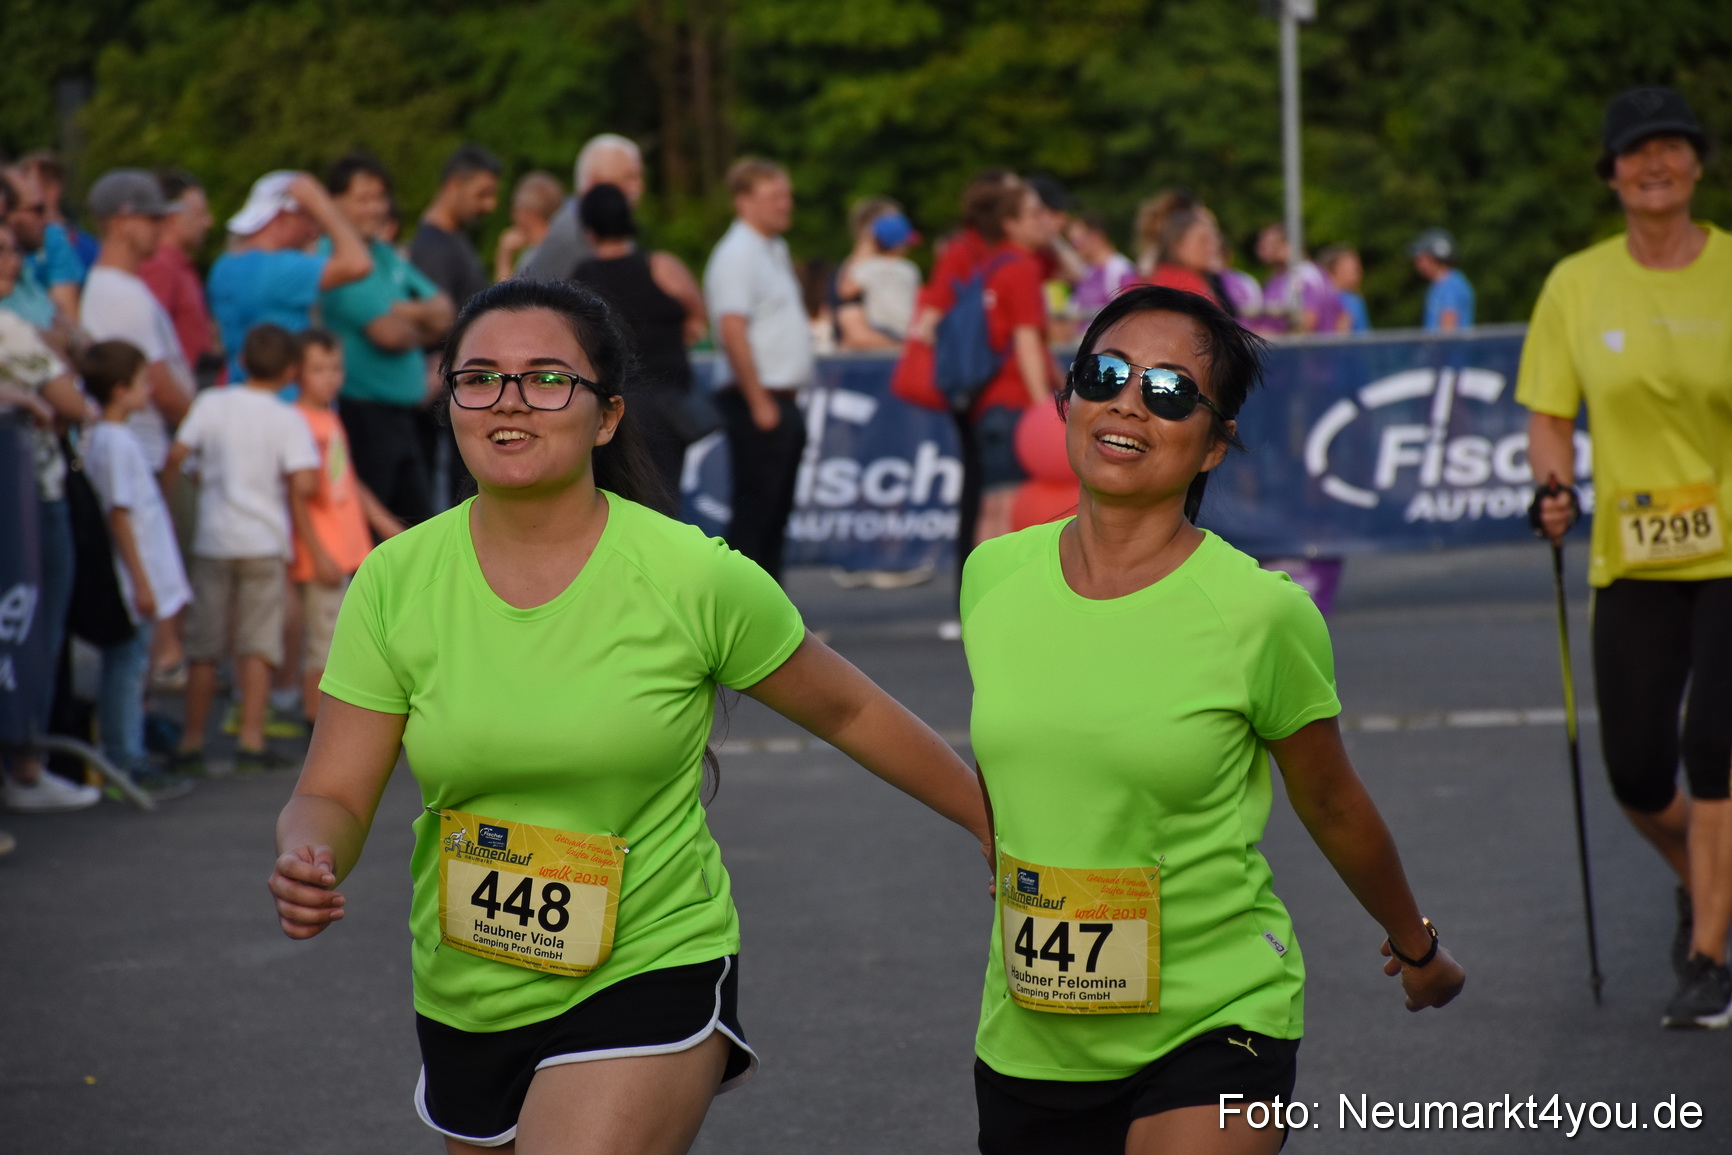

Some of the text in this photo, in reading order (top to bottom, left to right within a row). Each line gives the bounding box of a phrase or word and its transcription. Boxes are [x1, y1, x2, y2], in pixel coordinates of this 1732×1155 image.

[793, 441, 965, 506] isch
[1631, 508, 1712, 545] 1298
[465, 840, 534, 866] firmenlauf
[554, 833, 613, 857] Gesunde Firmen
[566, 847, 589, 860] laufen
[538, 865, 609, 887] walk 2019
[1087, 873, 1120, 885] Gesunde
[471, 870, 571, 933] 448
[1075, 904, 1147, 920] walk 2019
[472, 933, 509, 952] Camping
[511, 942, 532, 955] Profi
[534, 948, 563, 961] GmbH
[474, 919, 565, 950] Haubner Viola
[1014, 916, 1113, 973] 447
[1011, 964, 1127, 989] Haubner Felomina
[1016, 984, 1111, 1000] Camping Profi GmbH
